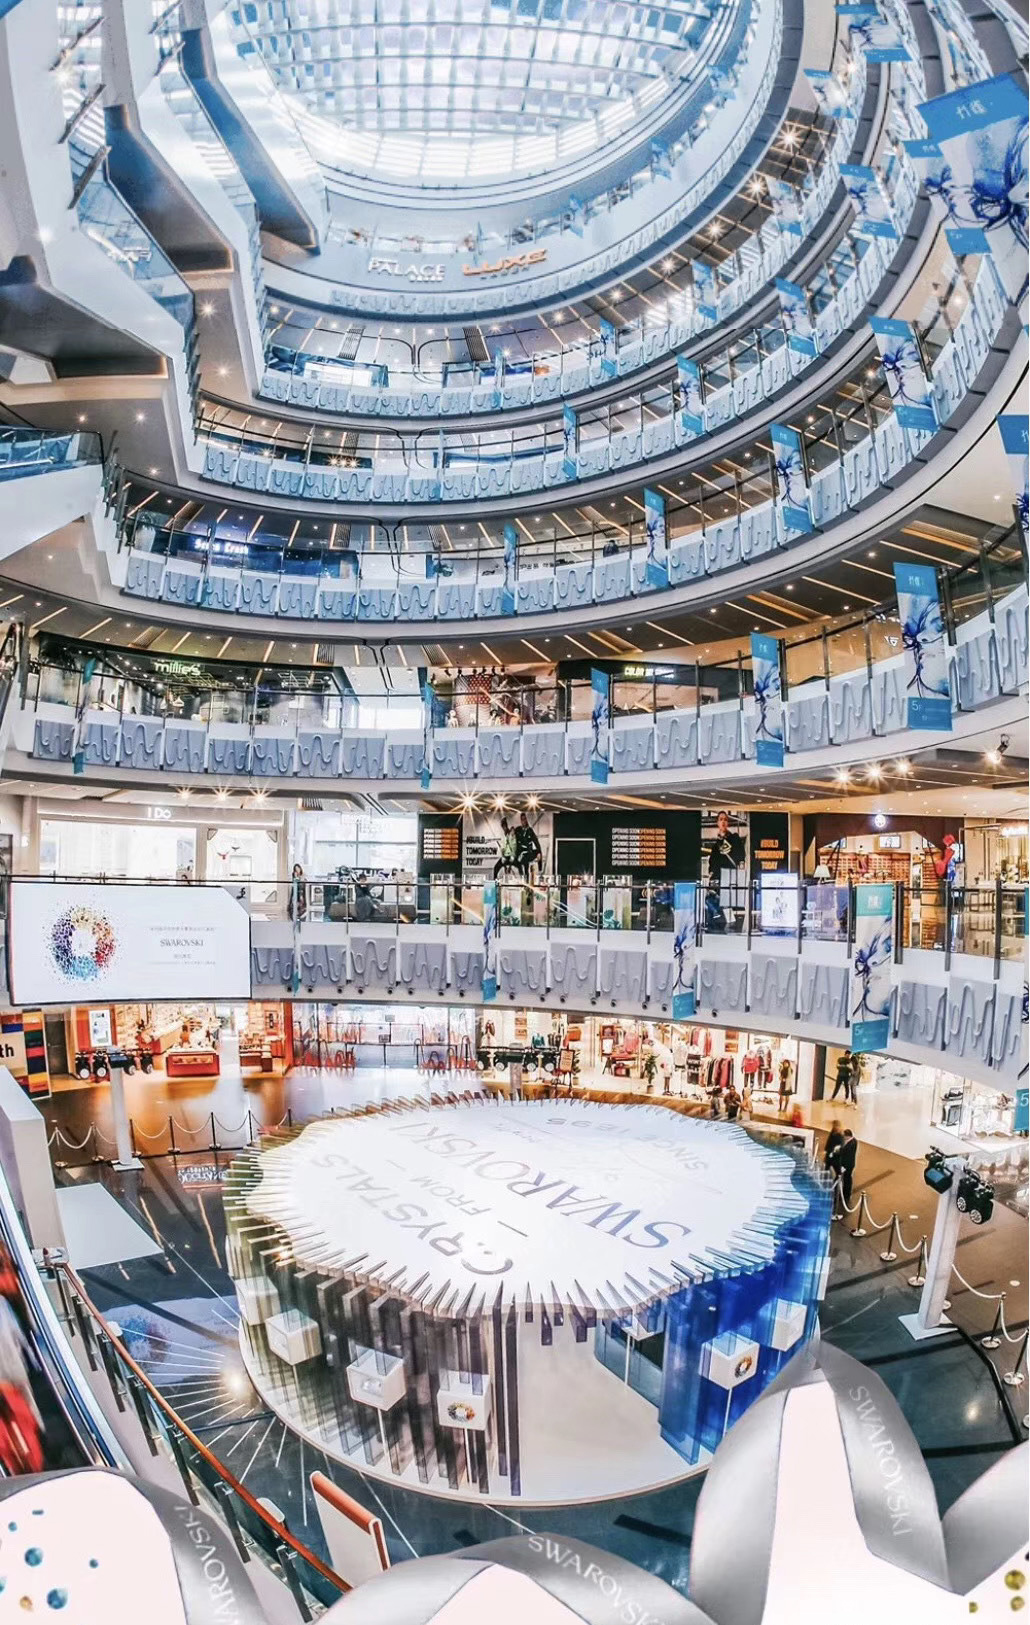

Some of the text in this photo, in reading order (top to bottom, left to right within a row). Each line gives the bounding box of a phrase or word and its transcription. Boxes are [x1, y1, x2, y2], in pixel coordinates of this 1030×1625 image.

[368, 257, 446, 277] PALACE
[463, 248, 547, 276] LUXE
[154, 661, 201, 676] millie's
[160, 939, 204, 947] SWAROVSKI
[388, 1121, 693, 1249] SWAROVSKI
[409, 1175, 492, 1216] FROM
[311, 1153, 514, 1276] CRYSTALS
